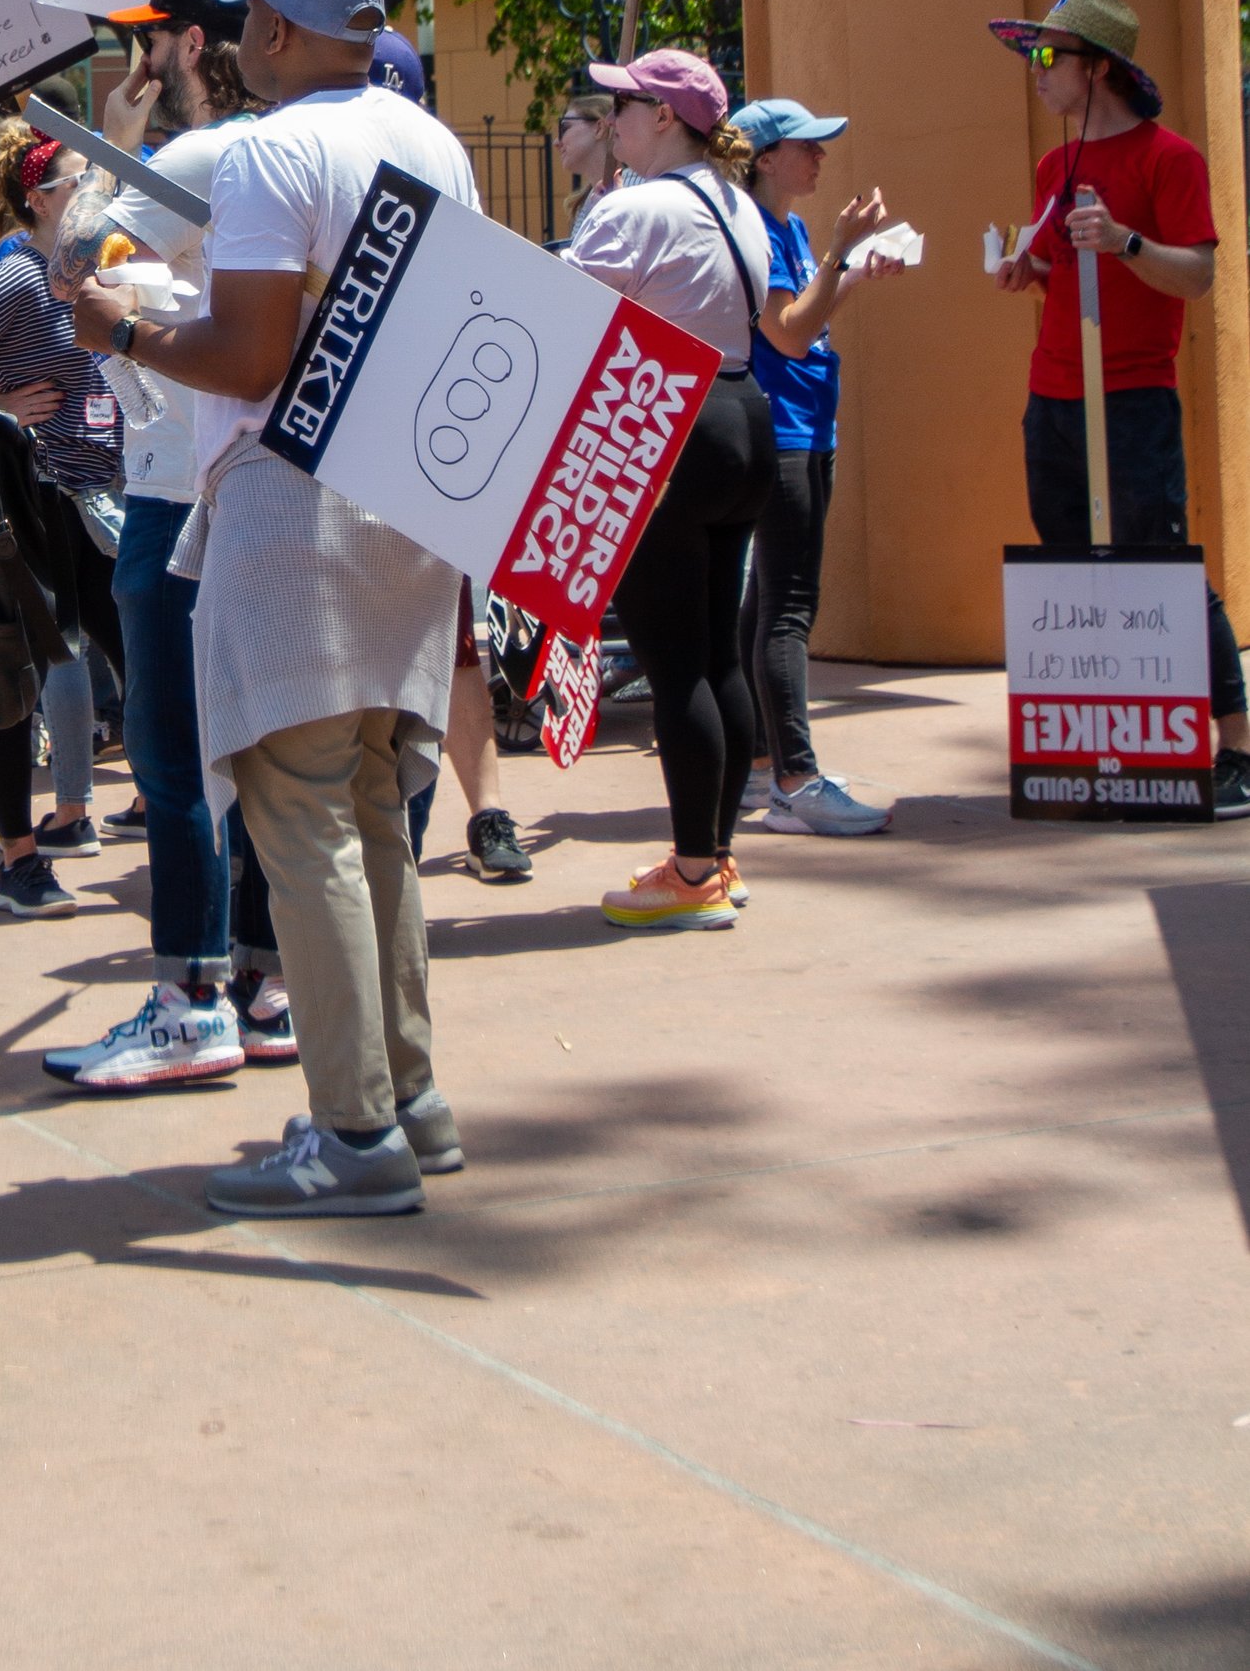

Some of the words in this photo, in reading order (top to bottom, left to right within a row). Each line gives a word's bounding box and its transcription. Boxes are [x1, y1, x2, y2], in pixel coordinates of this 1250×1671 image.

[279, 189, 417, 448] STRIKE
[511, 325, 642, 574] AMERICA
[573, 359, 664, 526] GUILD
[566, 374, 699, 610] WRITERS
[548, 524, 580, 582] OF
[1031, 599, 1108, 633] AMPTP
[1119, 600, 1171, 635] YOUR
[1130, 655, 1173, 684] I'LL
[1020, 702, 1199, 755] STRIKE!
[1098, 756, 1122, 775] ON
[1023, 777, 1090, 803] GUILD
[1094, 778, 1201, 805] WRITERS
